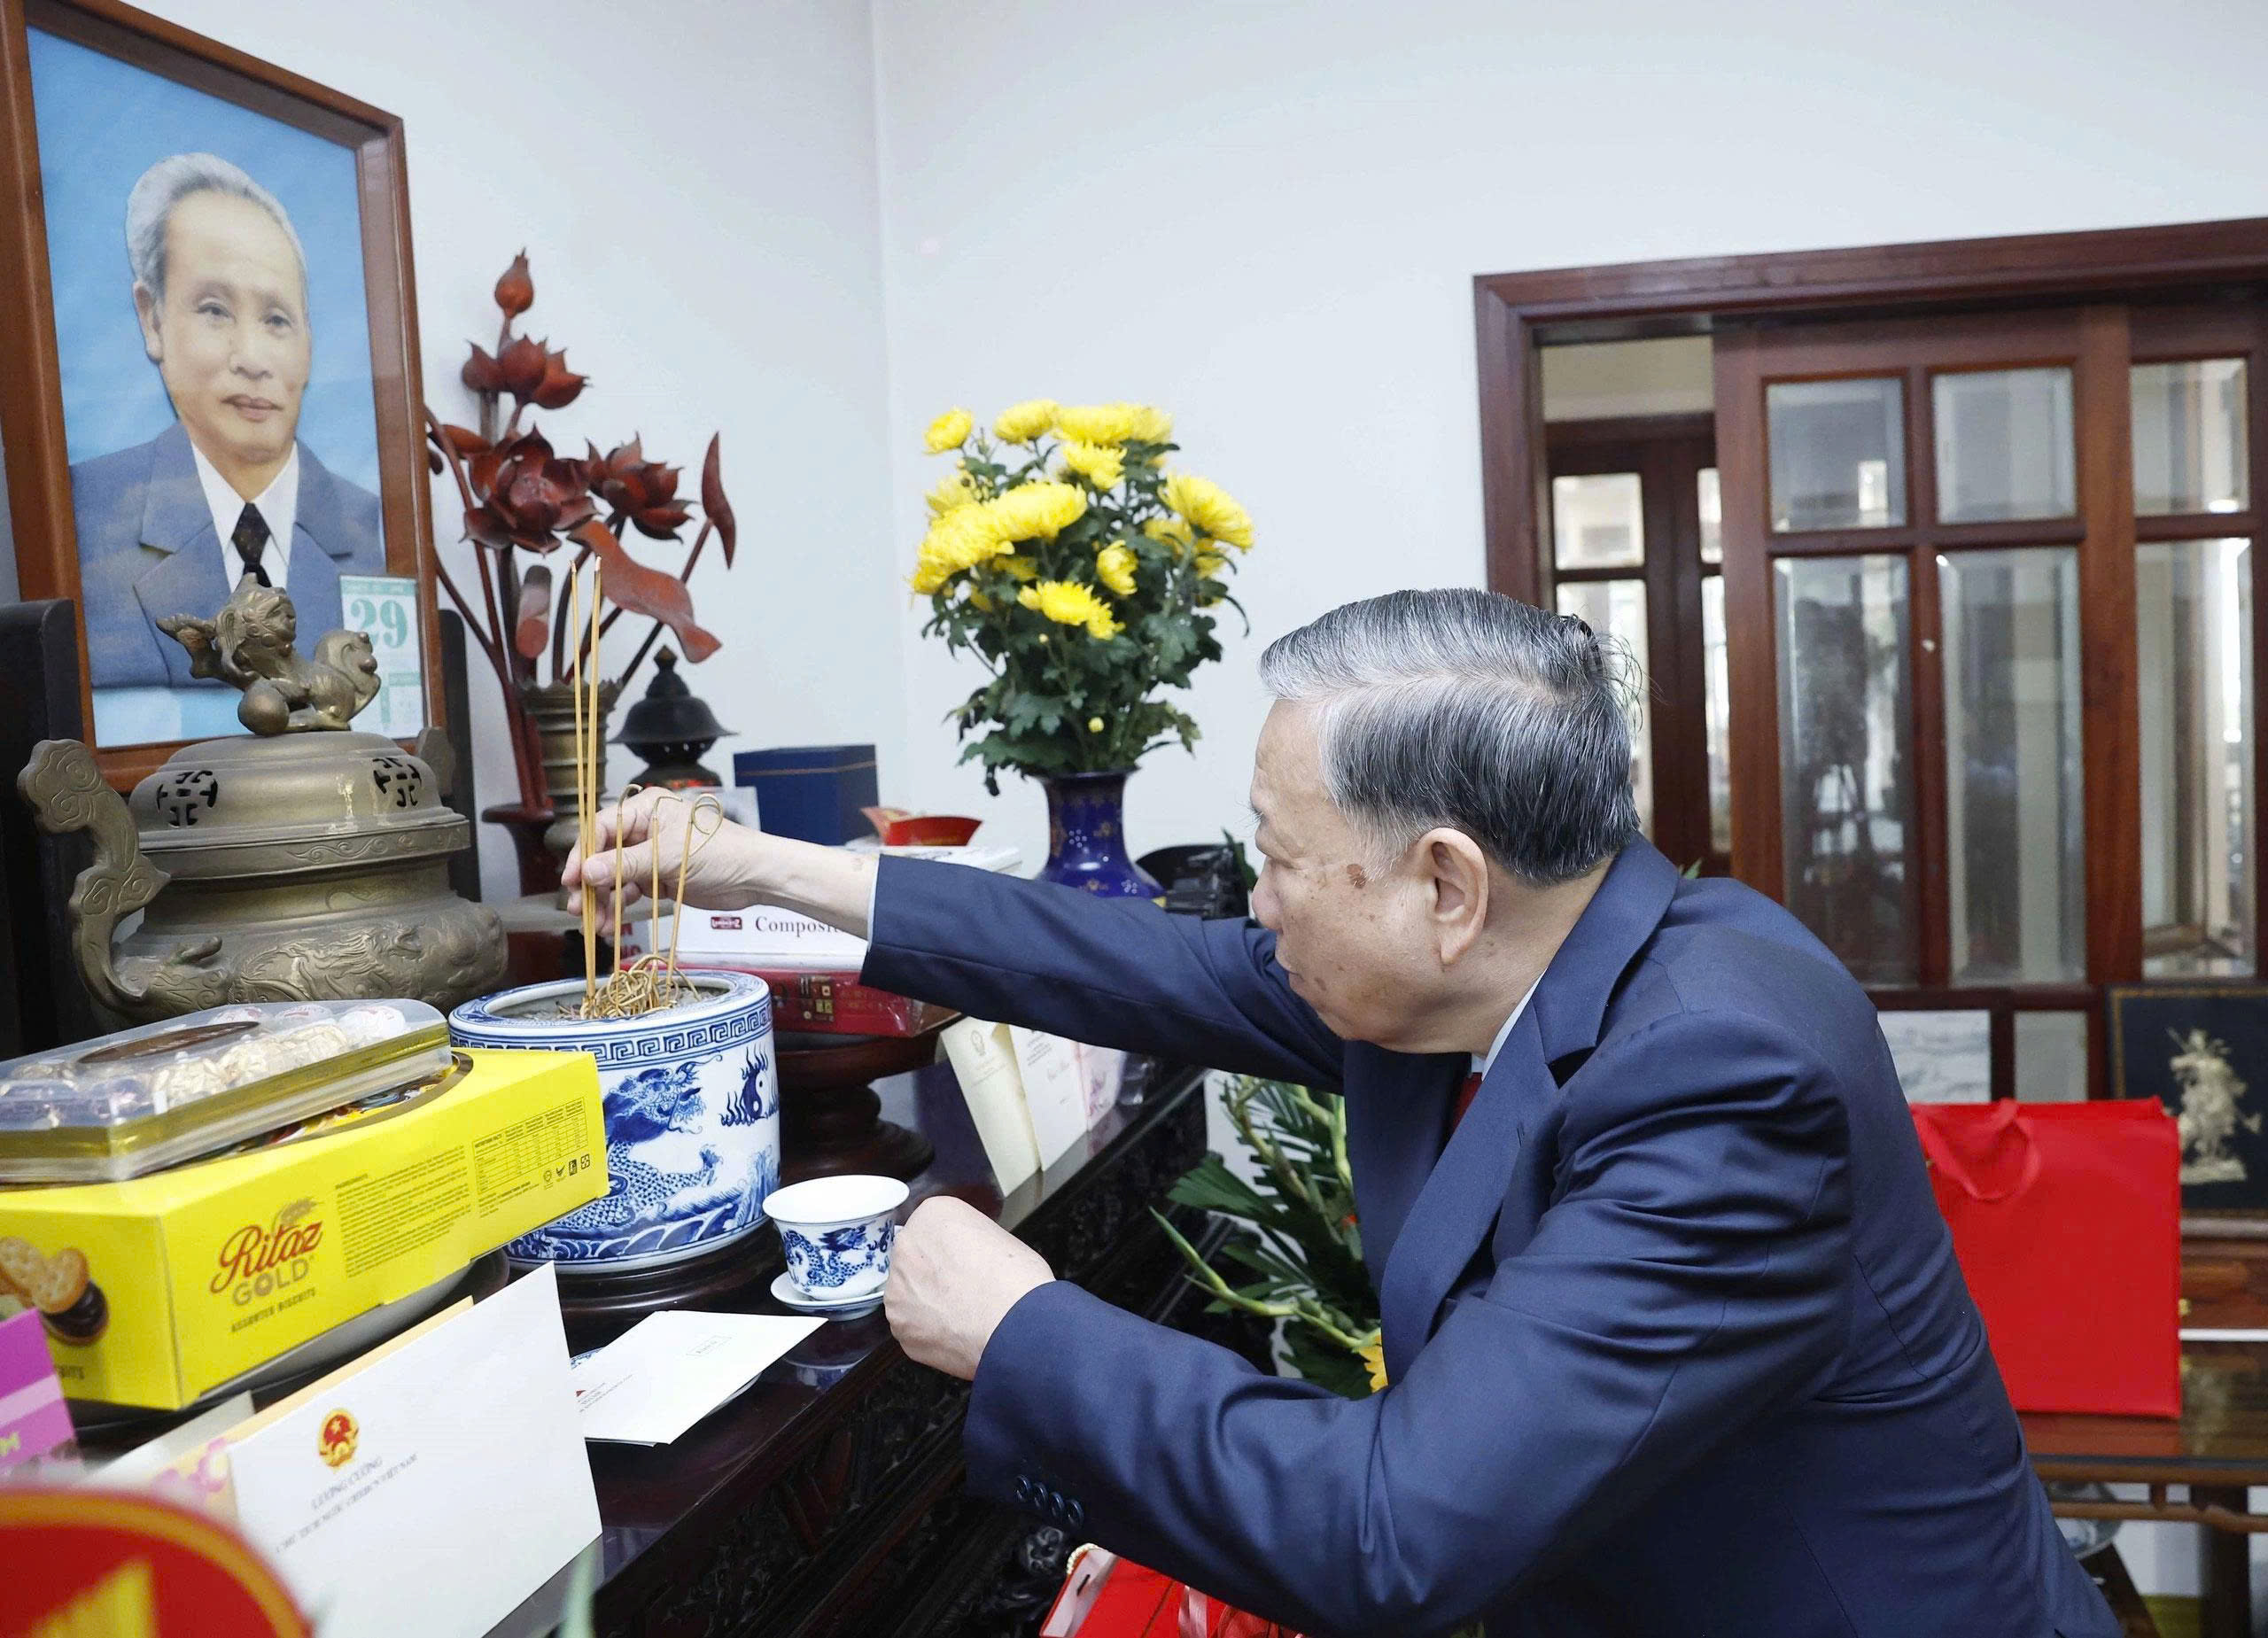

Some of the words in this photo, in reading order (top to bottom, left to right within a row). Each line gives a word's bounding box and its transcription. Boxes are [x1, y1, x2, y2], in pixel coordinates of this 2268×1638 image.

[350, 598, 408, 648] 29
[210, 1221, 323, 1293] Ritaz
[233, 1258, 309, 1305] GOLD
